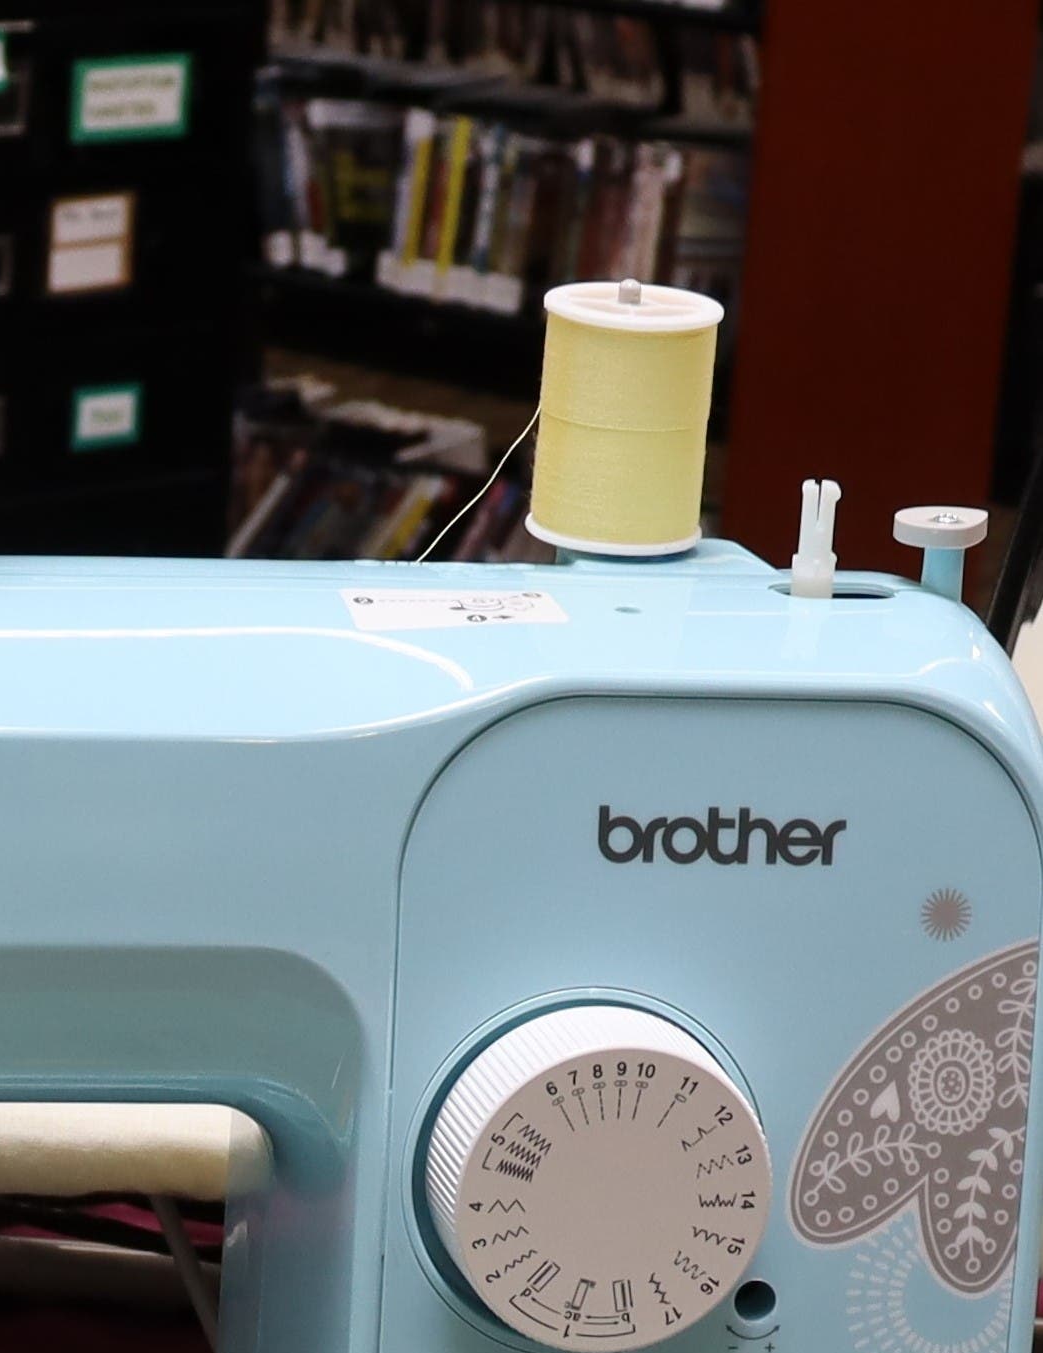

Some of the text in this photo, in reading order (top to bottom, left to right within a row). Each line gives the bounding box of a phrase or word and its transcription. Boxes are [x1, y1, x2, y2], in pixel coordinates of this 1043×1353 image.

[598, 805, 847, 866] brother
[592, 1064, 604, 1079] 8
[617, 1061, 627, 1076] 9
[636, 1062, 656, 1078] 10
[568, 1070, 578, 1085] 7
[679, 1076, 699, 1095] 11
[545, 1081, 559, 1096] 6
[714, 1105, 733, 1125] 12
[490, 1133, 506, 1146] 5
[735, 1145, 753, 1165] 13
[468, 1202, 483, 1212] 4
[740, 1190, 756, 1210] 14
[472, 1238, 487, 1249] 3
[727, 1236, 746, 1256] 15
[485, 1270, 501, 1284] 2
[699, 1277, 720, 1296] 16
[664, 1308, 682, 1326] 17
